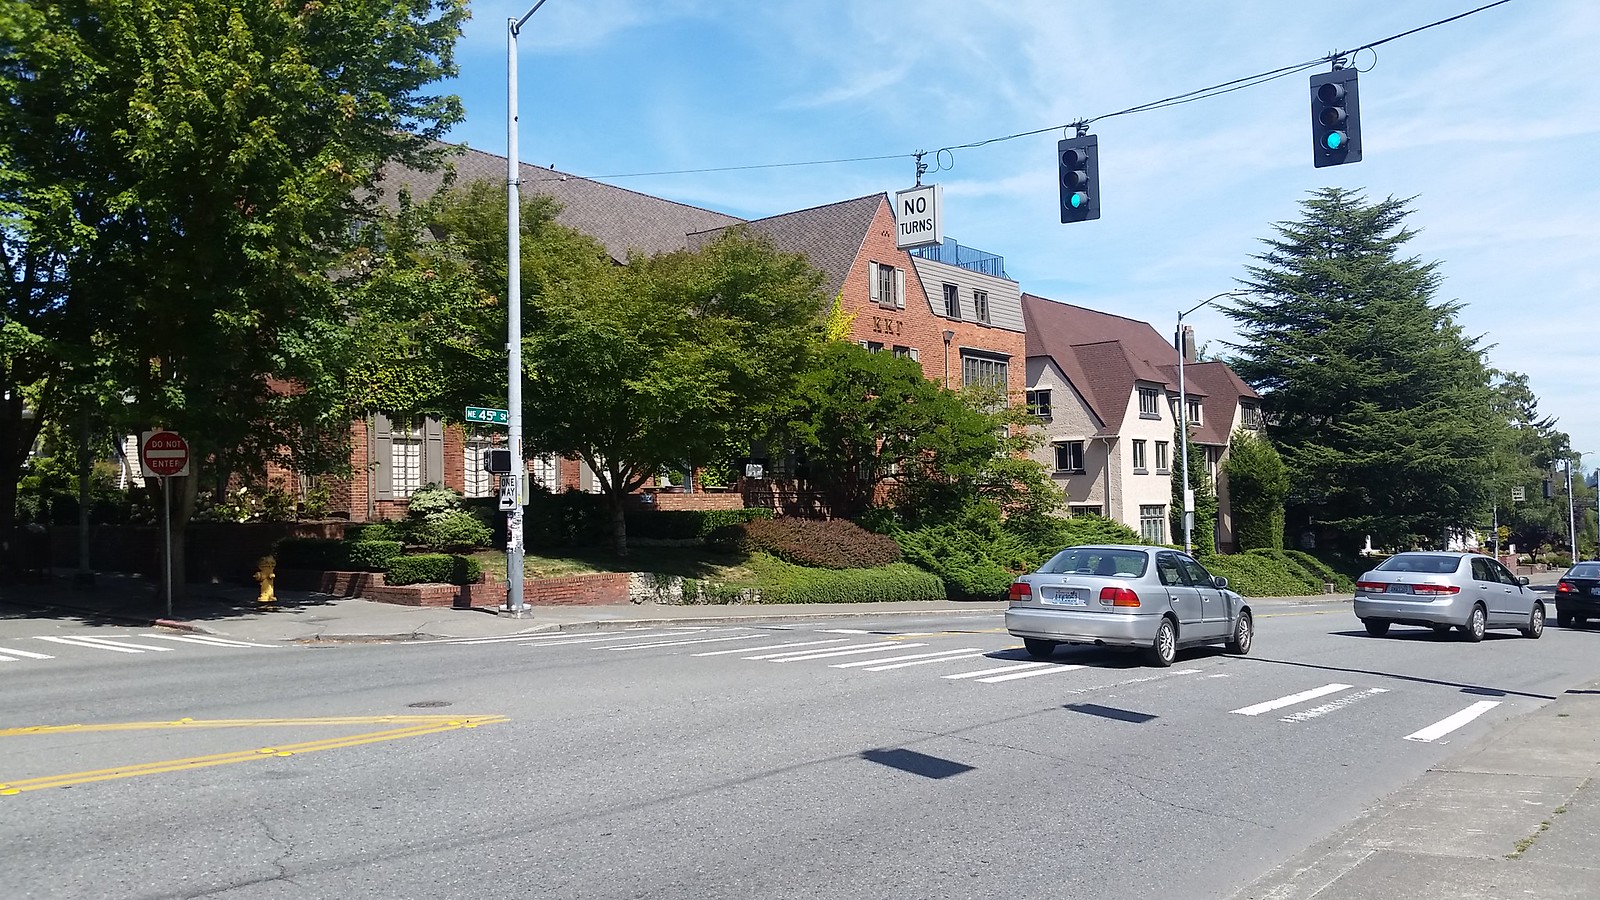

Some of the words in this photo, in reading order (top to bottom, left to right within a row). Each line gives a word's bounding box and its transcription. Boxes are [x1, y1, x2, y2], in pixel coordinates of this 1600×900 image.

[904, 196, 927, 216] NO
[900, 218, 933, 236] TURNS
[467, 410, 477, 419] NE
[151, 440, 163, 448] DO
[166, 440, 181, 448] NOT
[501, 478, 515, 487] ONE
[501, 487, 515, 496] WAY
